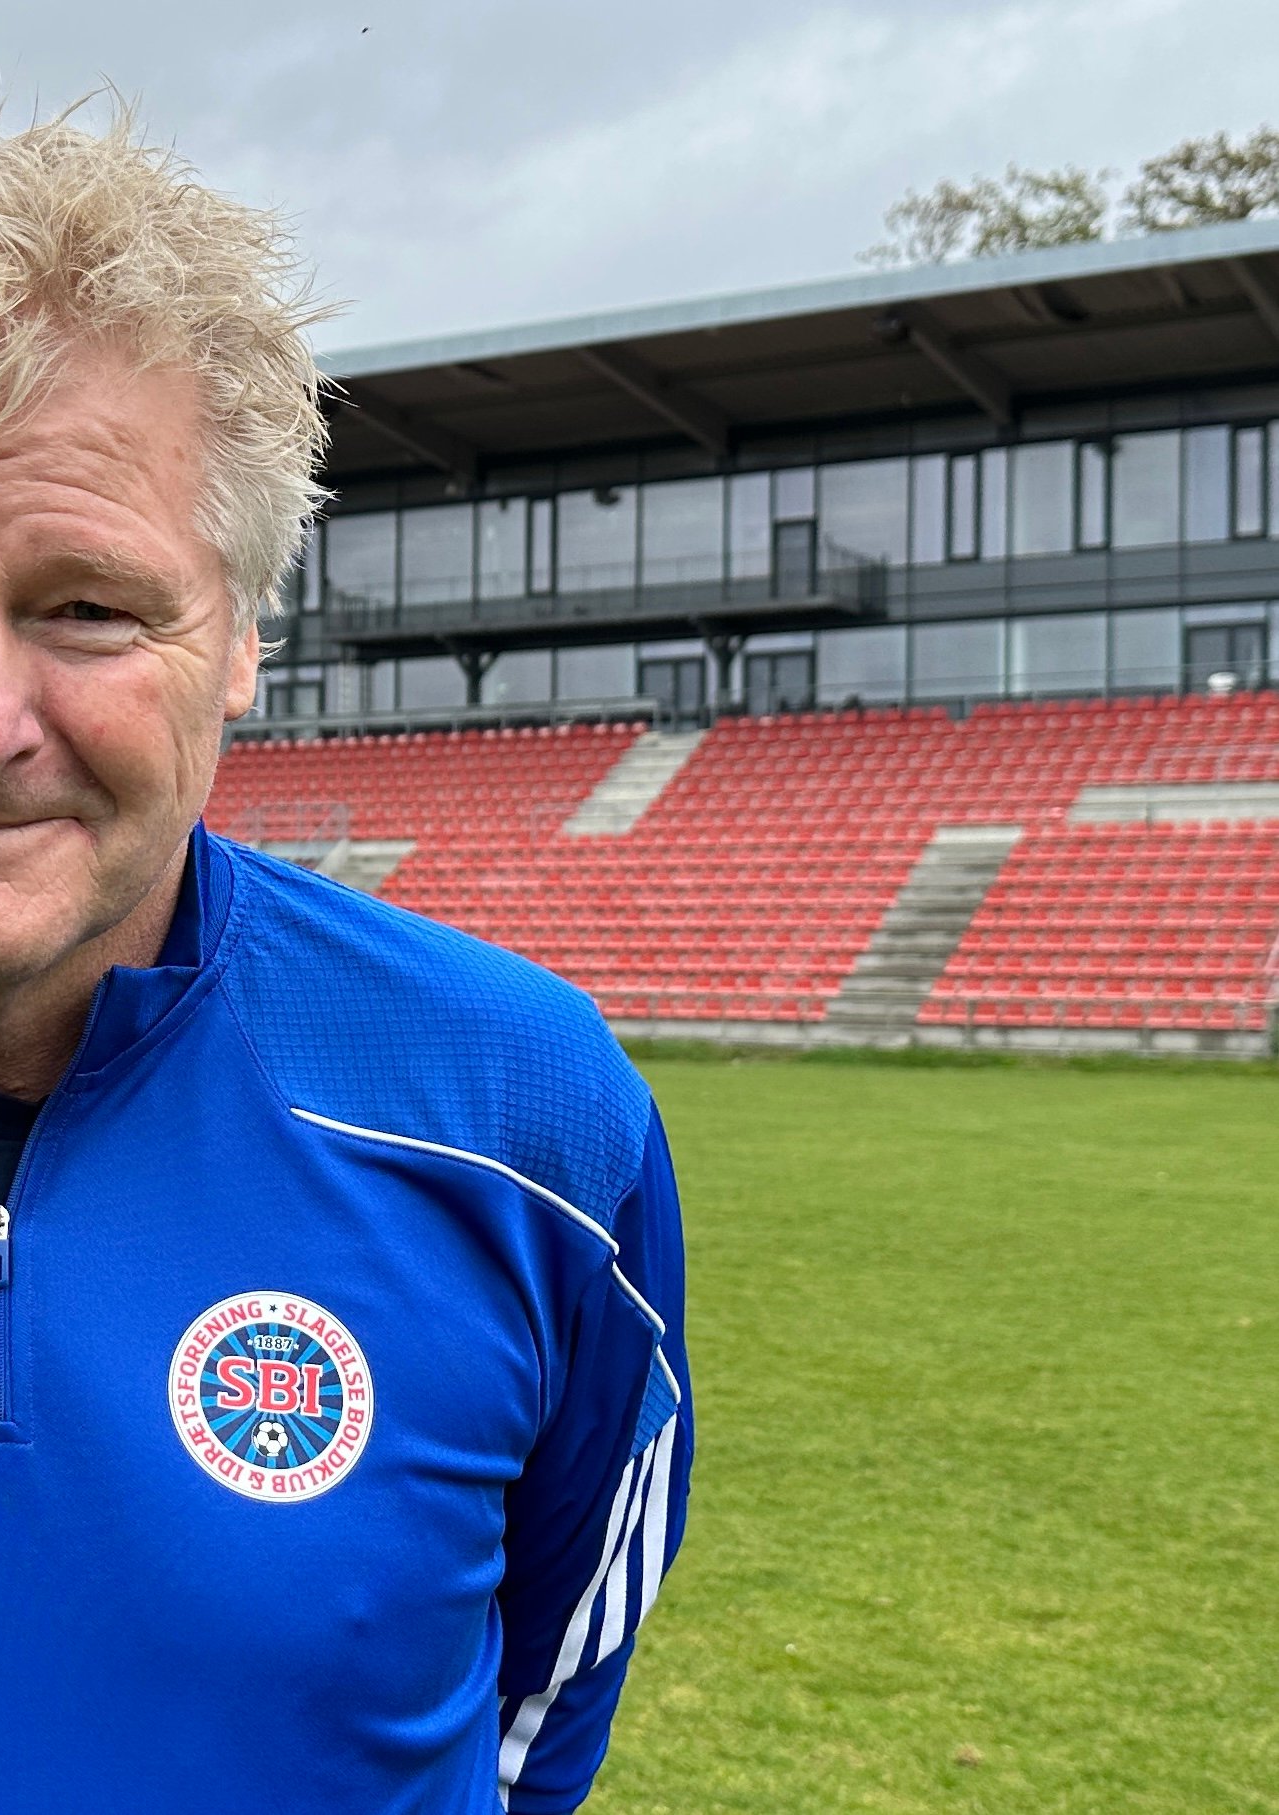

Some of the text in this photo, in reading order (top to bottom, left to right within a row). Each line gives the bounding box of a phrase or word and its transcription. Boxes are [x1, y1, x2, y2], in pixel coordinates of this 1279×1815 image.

[255, 1335, 293, 1350] 1887
[177, 1300, 365, 1493] SLAGELSE BOLDKLUB & IDRÆTSFORENING
[218, 1357, 321, 1416] SBI
